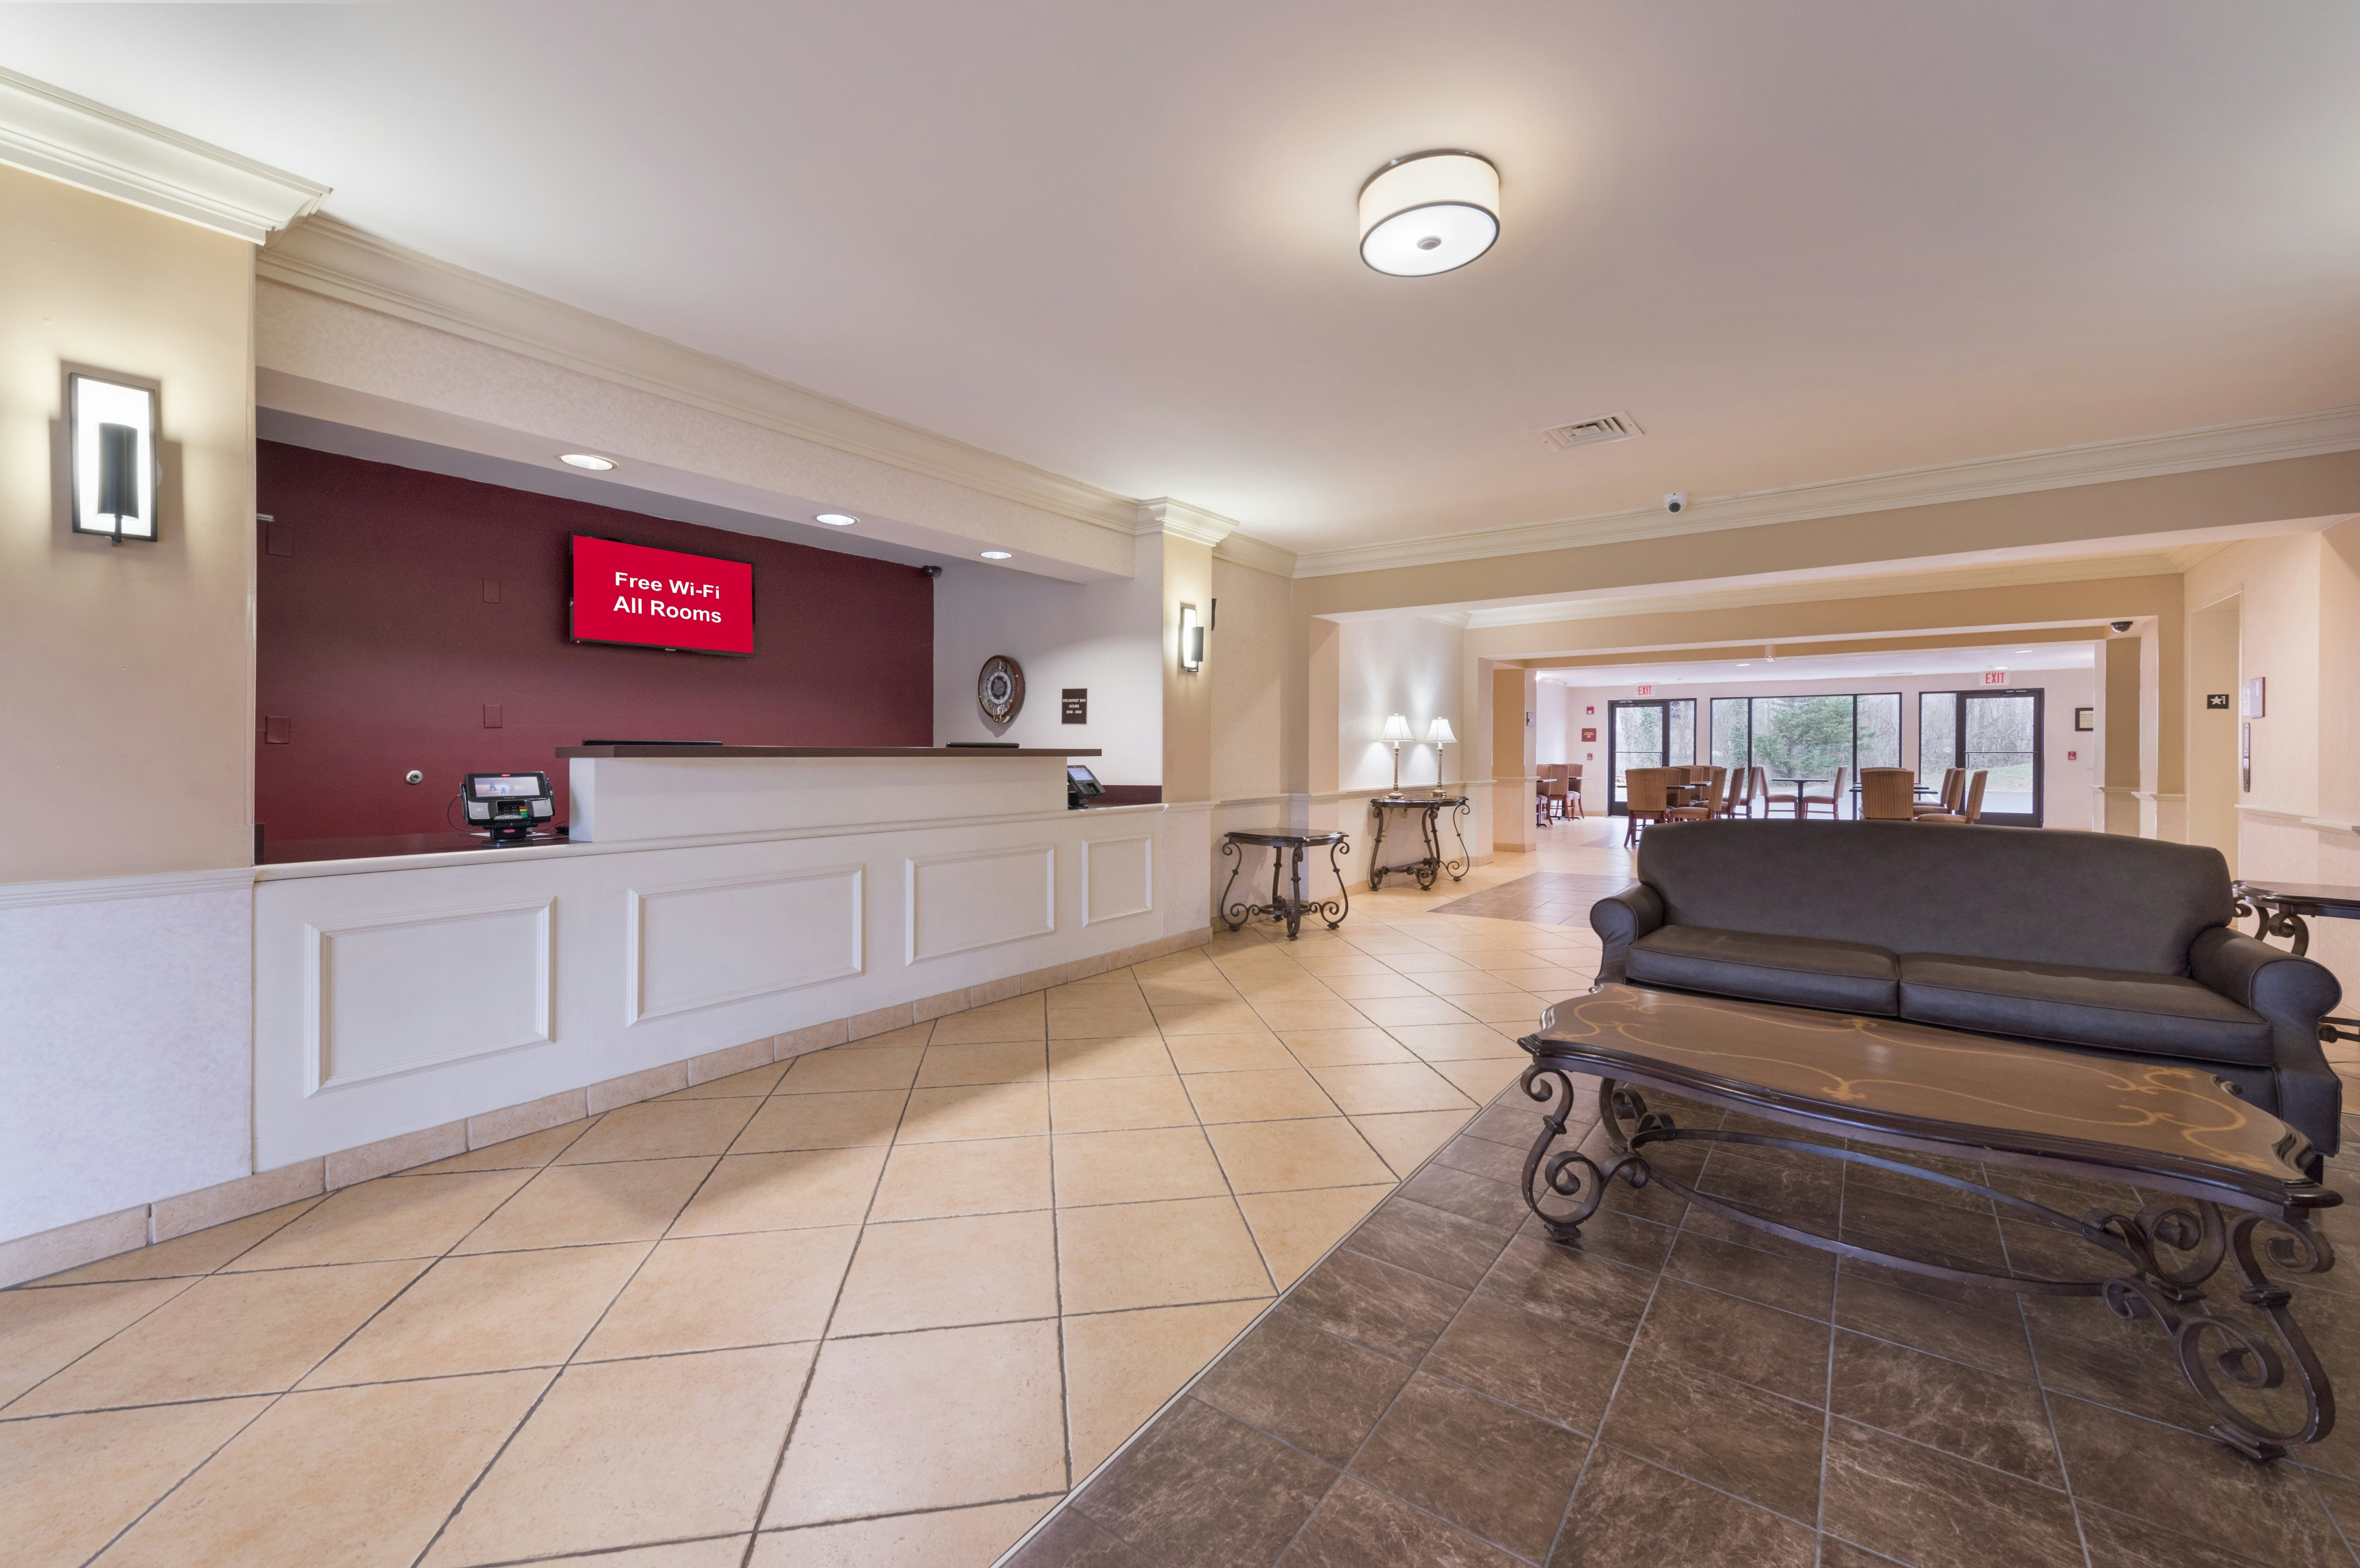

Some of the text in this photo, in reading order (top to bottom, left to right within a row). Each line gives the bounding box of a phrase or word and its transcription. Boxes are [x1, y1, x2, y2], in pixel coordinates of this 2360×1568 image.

[615, 571, 720, 600] Free Wi-Fi
[613, 595, 722, 623] All Rooms
[1985, 673, 2005, 684] EXIT
[1638, 685, 1652, 695] EXIT
